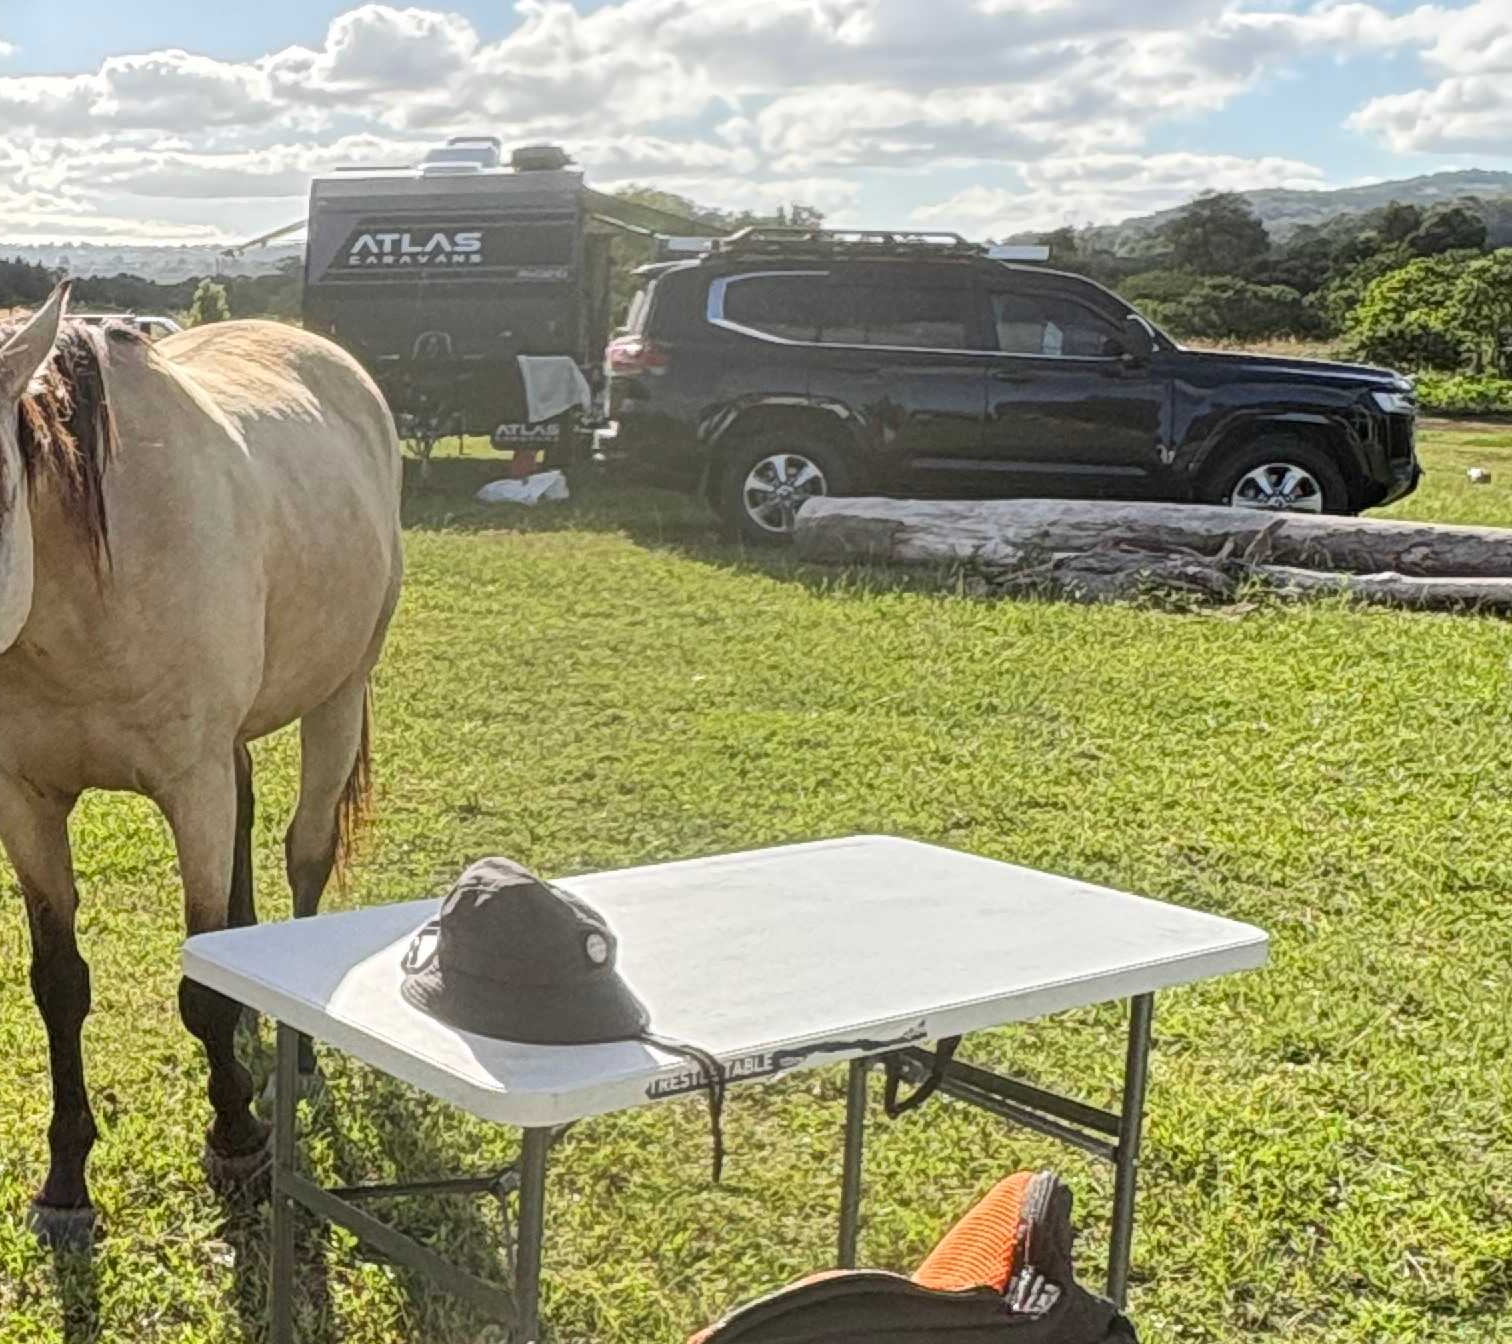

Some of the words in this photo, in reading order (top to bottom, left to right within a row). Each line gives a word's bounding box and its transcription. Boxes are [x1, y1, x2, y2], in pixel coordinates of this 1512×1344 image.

[350, 232, 482, 254] ATLAS
[349, 254, 483, 266] CARAVANS
[494, 423, 560, 437] ATLAS
[649, 1067, 719, 1097] TRESTL
[723, 1054, 774, 1080] TABLE
